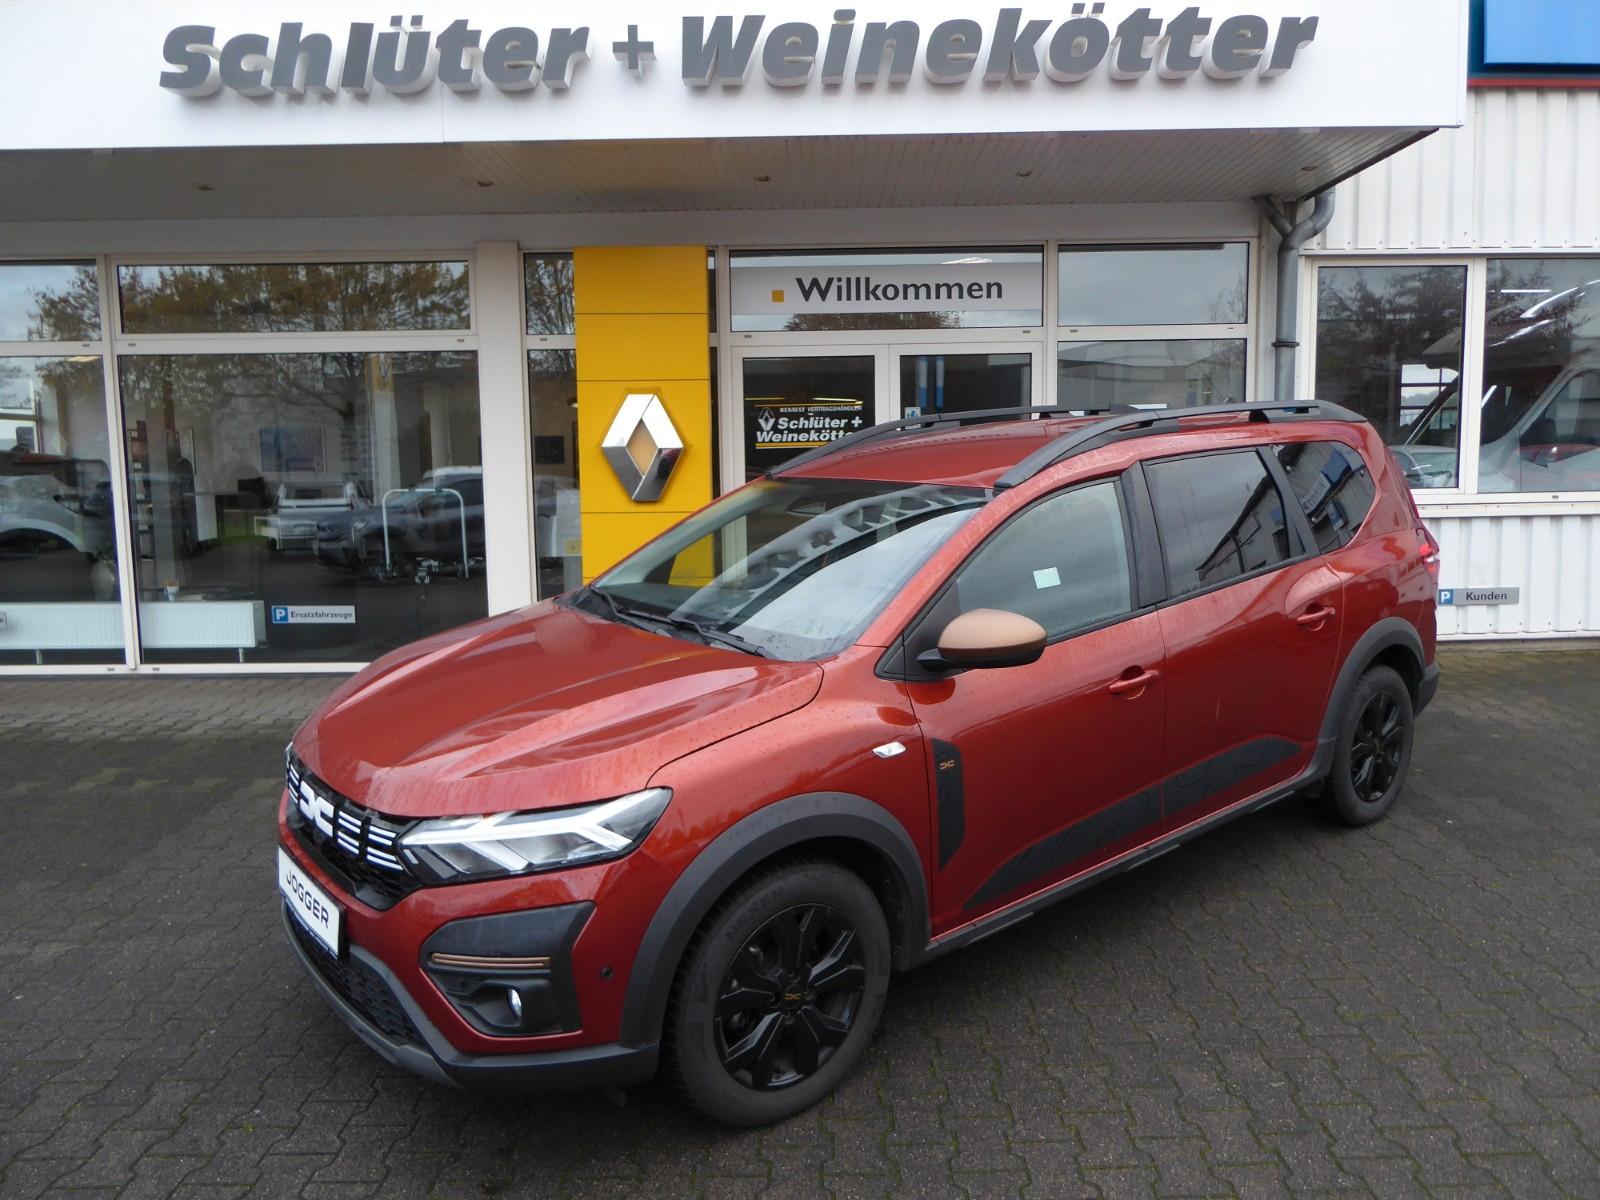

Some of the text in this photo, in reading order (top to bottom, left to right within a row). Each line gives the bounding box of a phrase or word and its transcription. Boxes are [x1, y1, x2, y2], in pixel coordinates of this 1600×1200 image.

[160, 3, 1319, 95] Schlüter + Weinekötter
[795, 276, 1003, 302] Willkommen
[777, 416, 863, 429] Schlüter +
[1466, 591, 1507, 600] Kunden
[291, 611, 352, 619] Ersatzfahrzeuge
[286, 870, 329, 928] JOGGER
